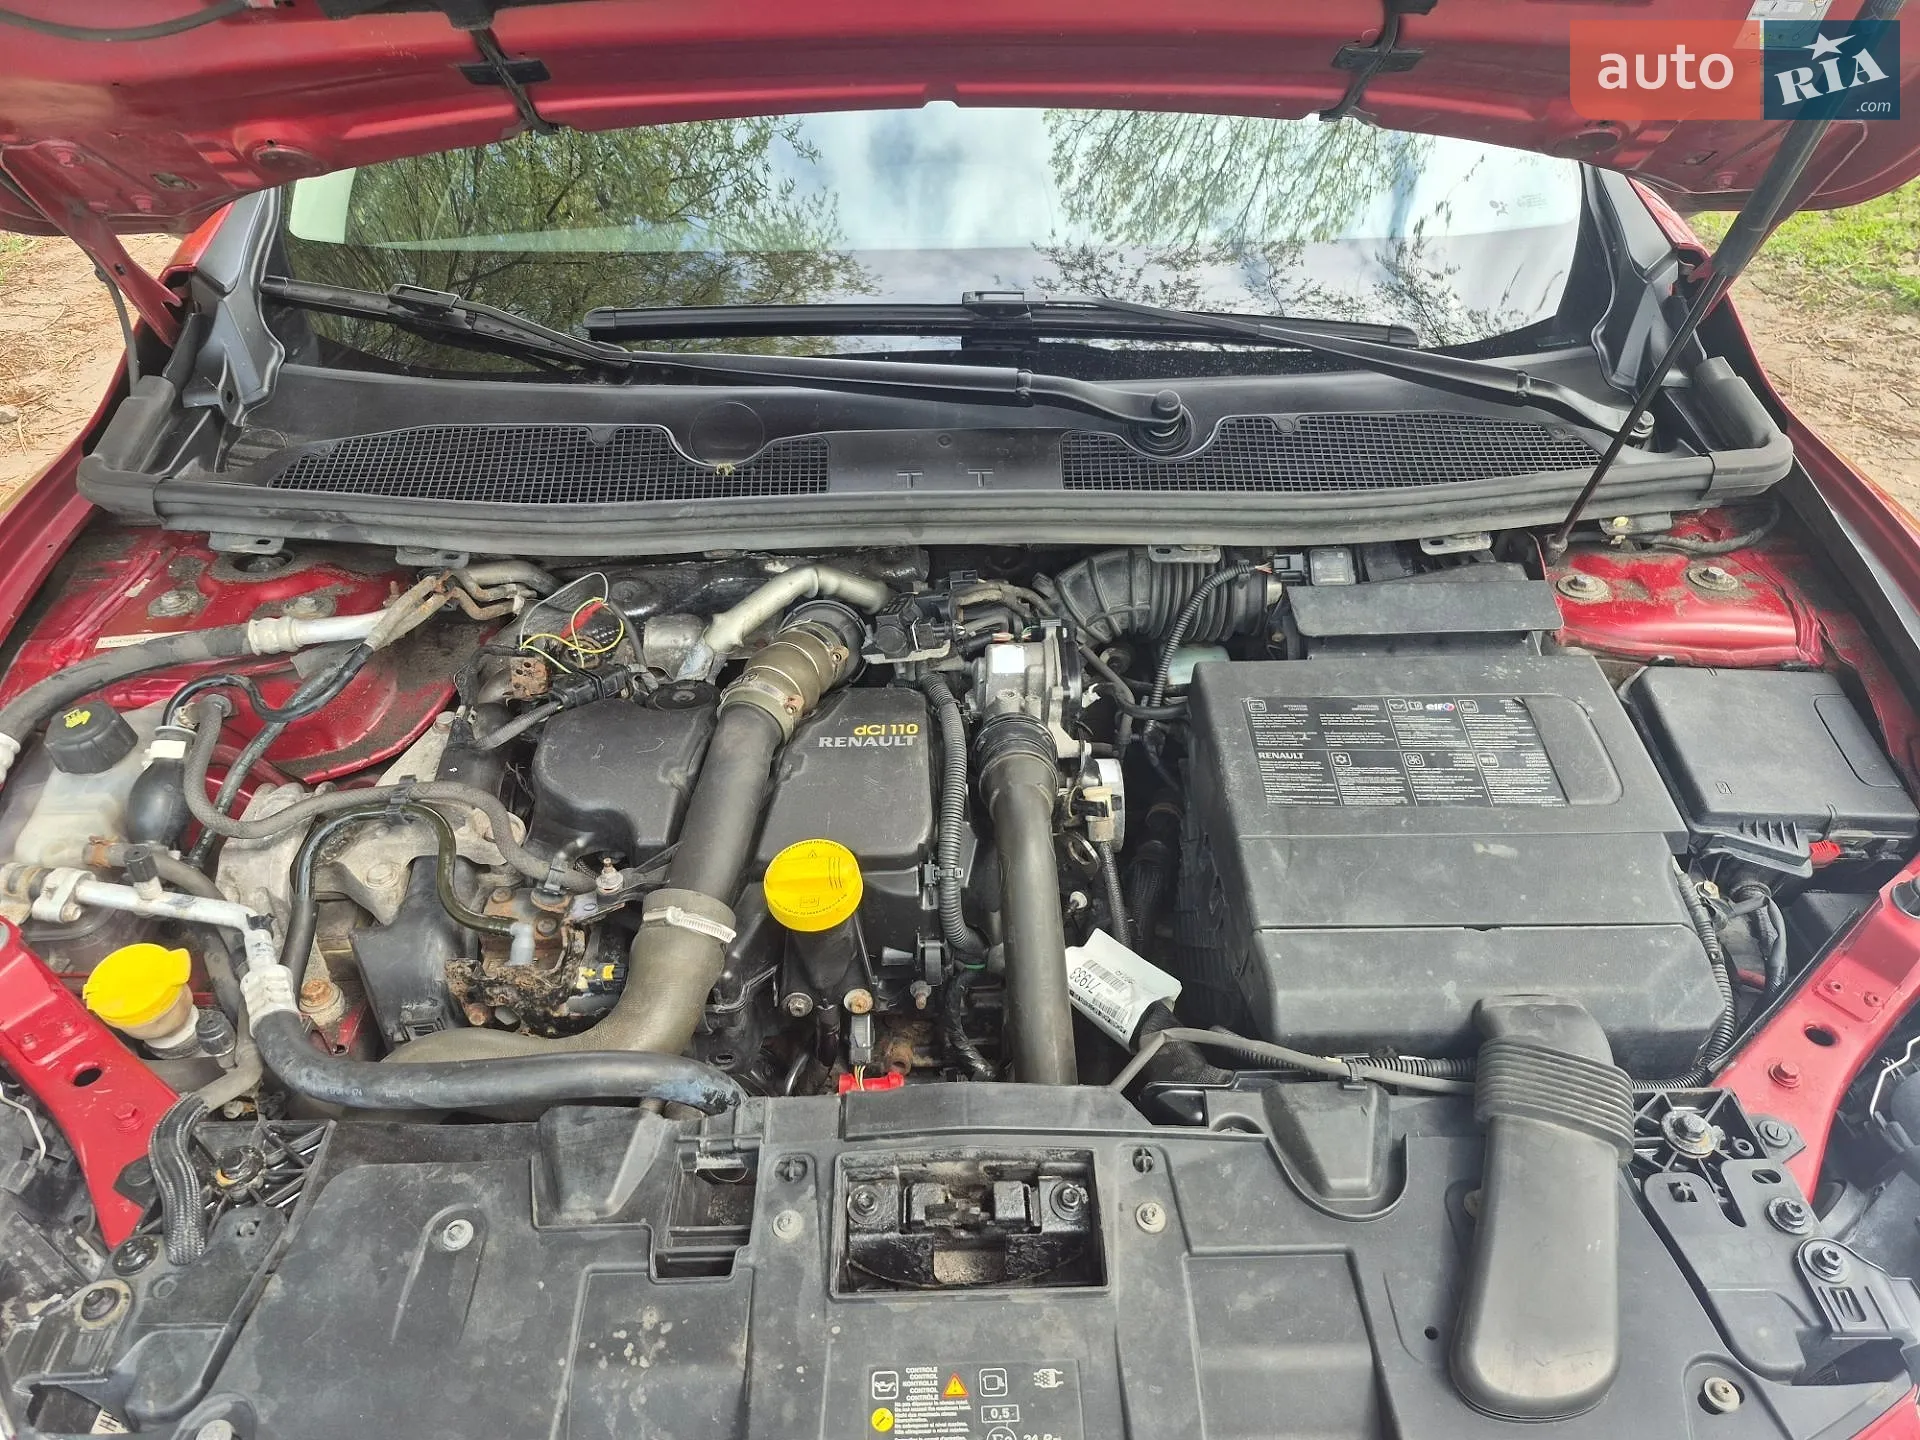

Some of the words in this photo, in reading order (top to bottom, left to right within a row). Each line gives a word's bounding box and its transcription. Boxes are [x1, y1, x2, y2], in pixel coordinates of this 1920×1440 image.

[890, 723, 919, 735] 110
[818, 735, 917, 748] RENAULT
[1258, 752, 1305, 760] RENAULT
[1069, 967, 1101, 994] 71933
[990, 1407, 1010, 1420] 0,5
